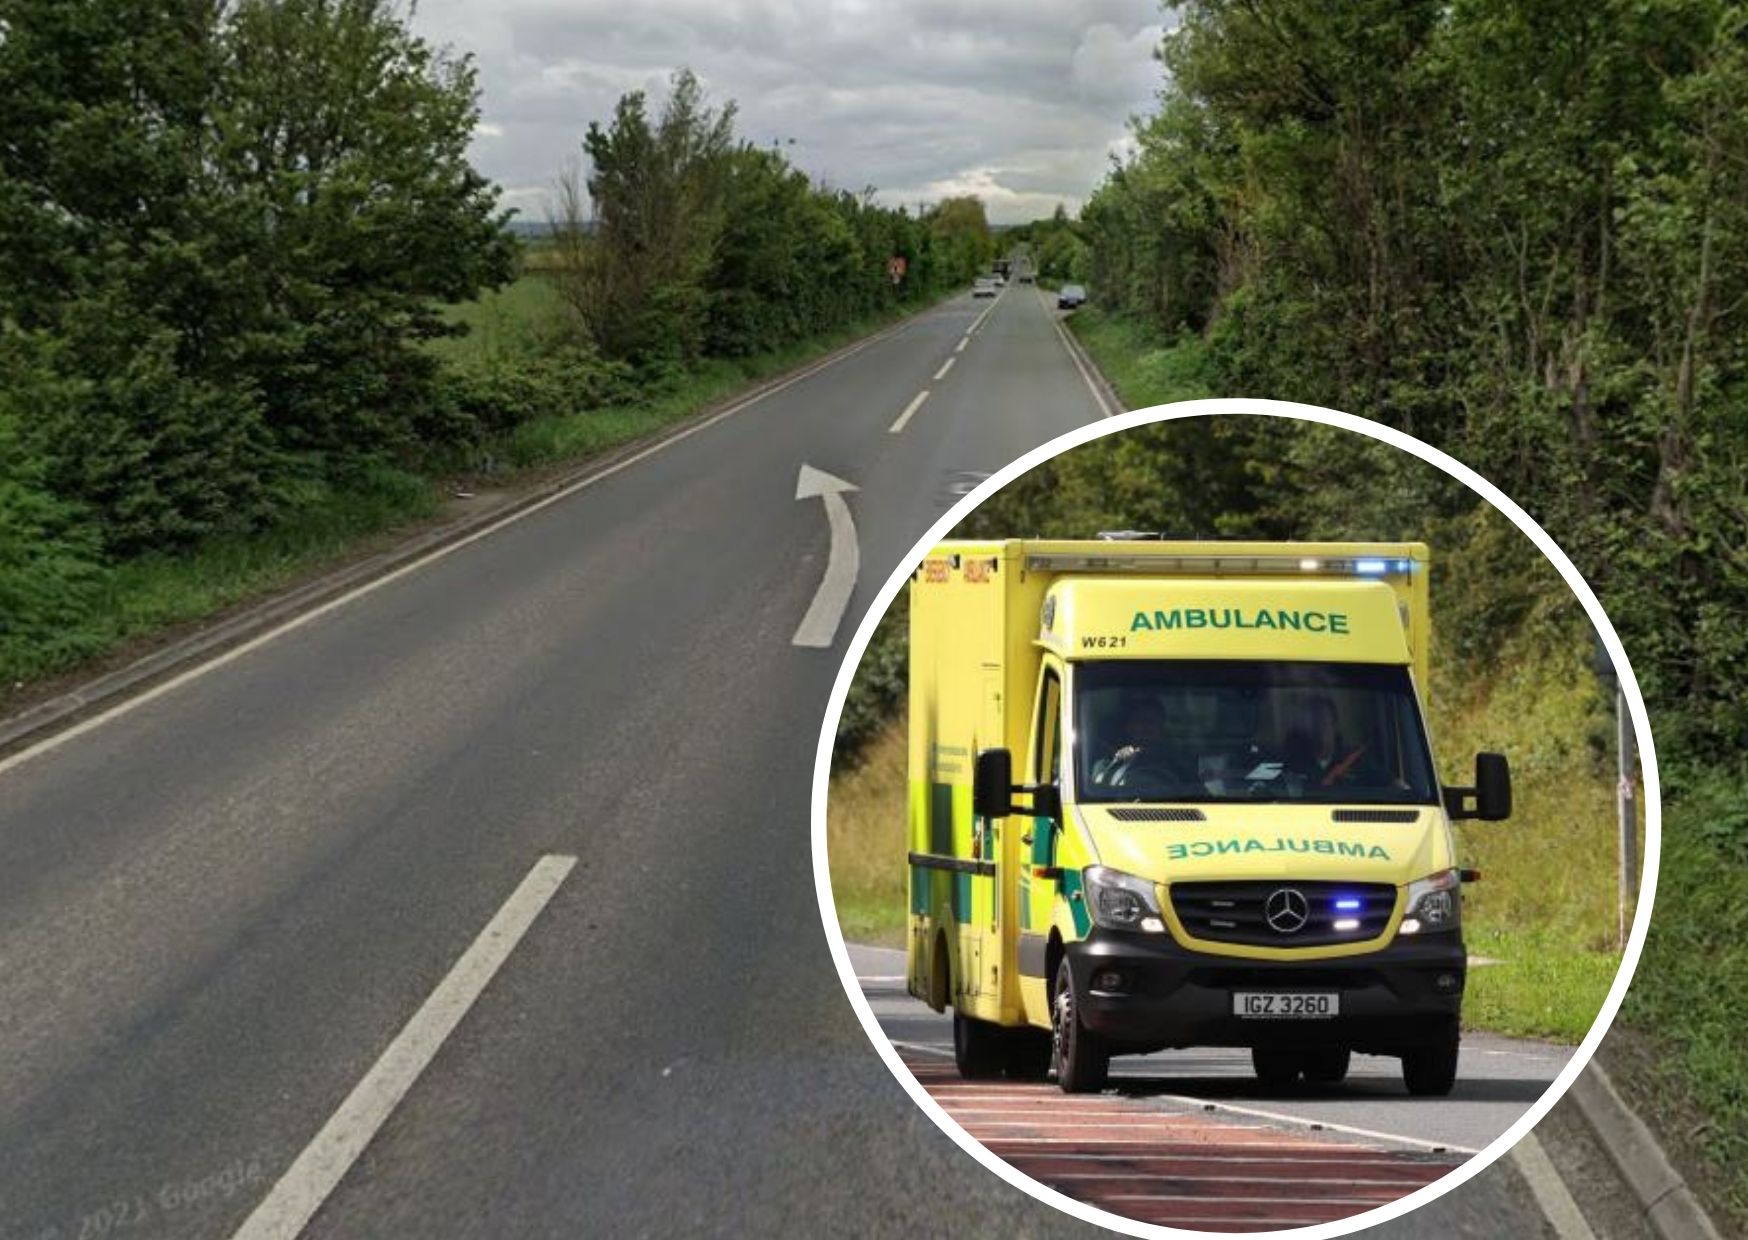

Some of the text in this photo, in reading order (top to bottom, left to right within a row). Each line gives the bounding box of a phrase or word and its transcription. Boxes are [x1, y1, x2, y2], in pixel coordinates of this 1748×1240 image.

[1130, 608, 1350, 635] AMBULANCE
[1081, 636, 1127, 649] W621
[1244, 995, 1330, 1014] IGZ 3260
